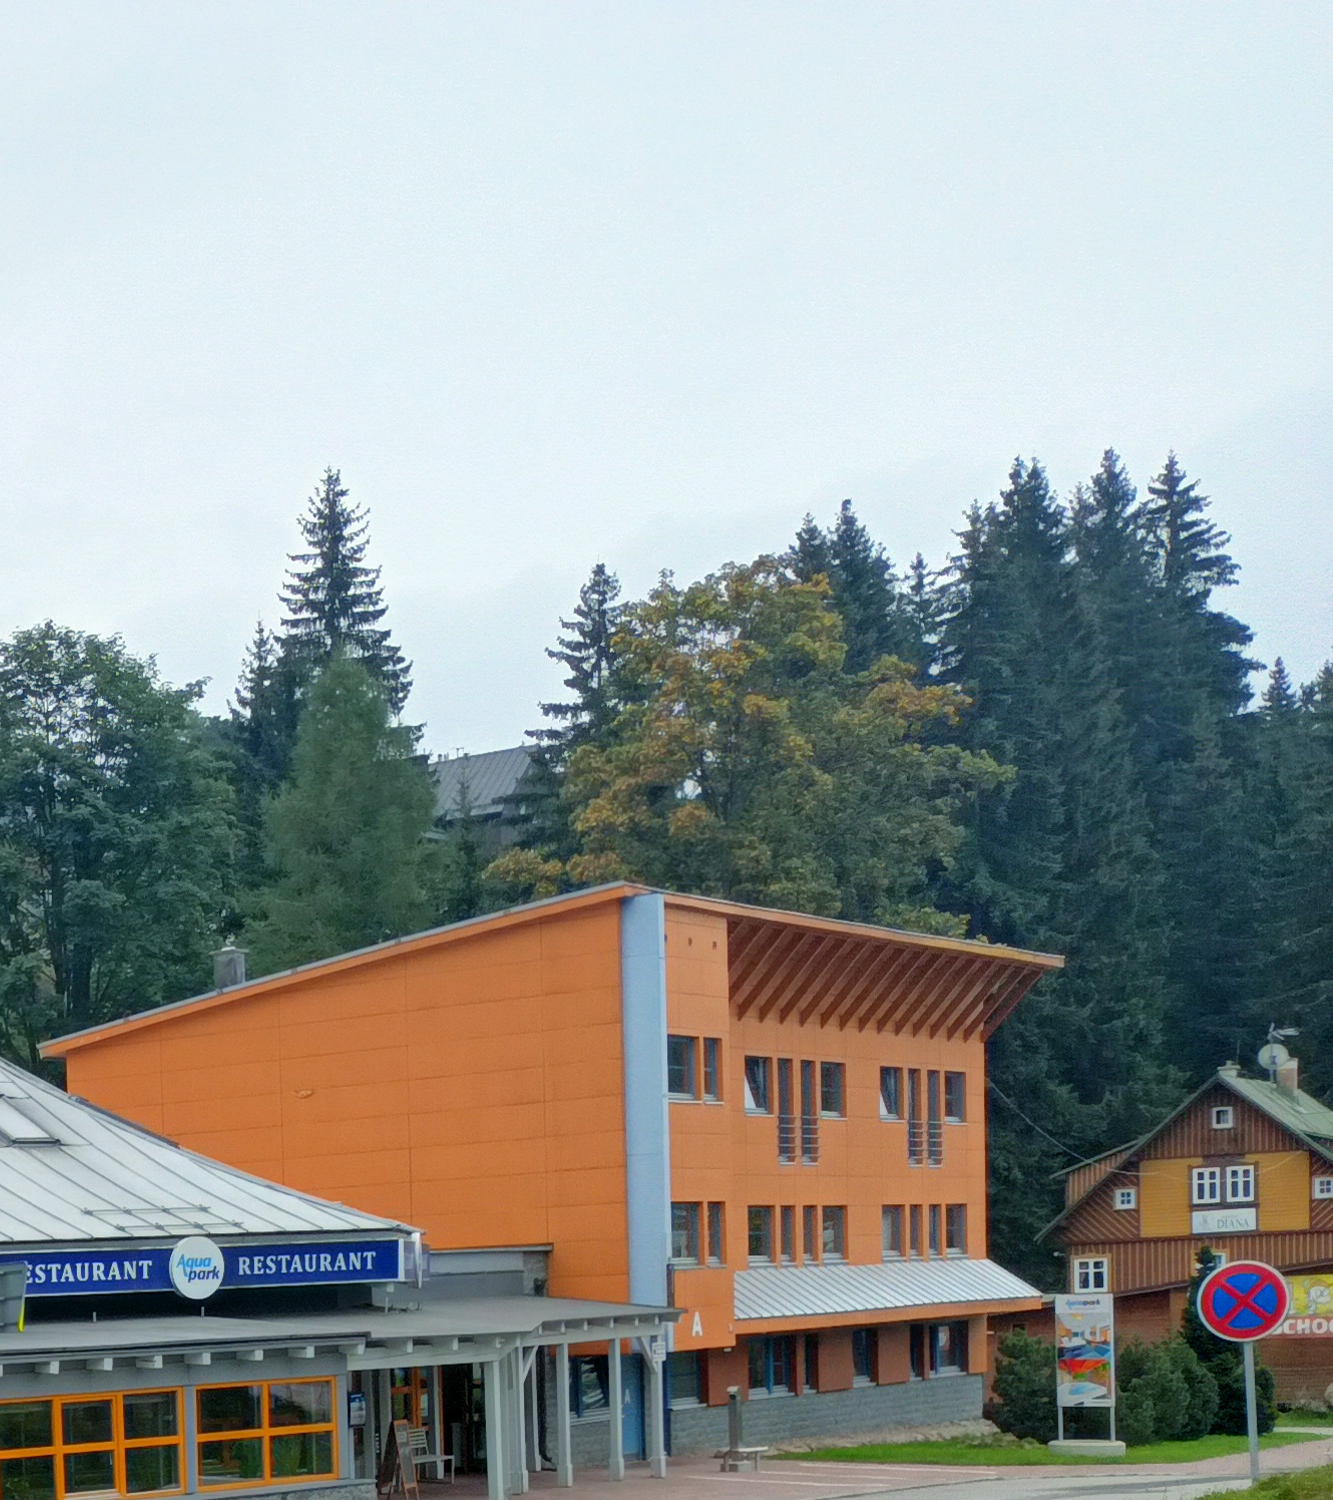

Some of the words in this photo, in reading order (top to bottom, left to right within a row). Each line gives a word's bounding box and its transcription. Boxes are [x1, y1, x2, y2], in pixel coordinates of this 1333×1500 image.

[1217, 1218, 1250, 1229] DIANA
[25, 1260, 153, 1284] ESTAURANT
[176, 1254, 212, 1277] Aqua
[187, 1266, 220, 1283] park
[238, 1251, 377, 1275] RESTAURANT
[691, 1311, 703, 1336] A
[1271, 1318, 1333, 1335] CHO
